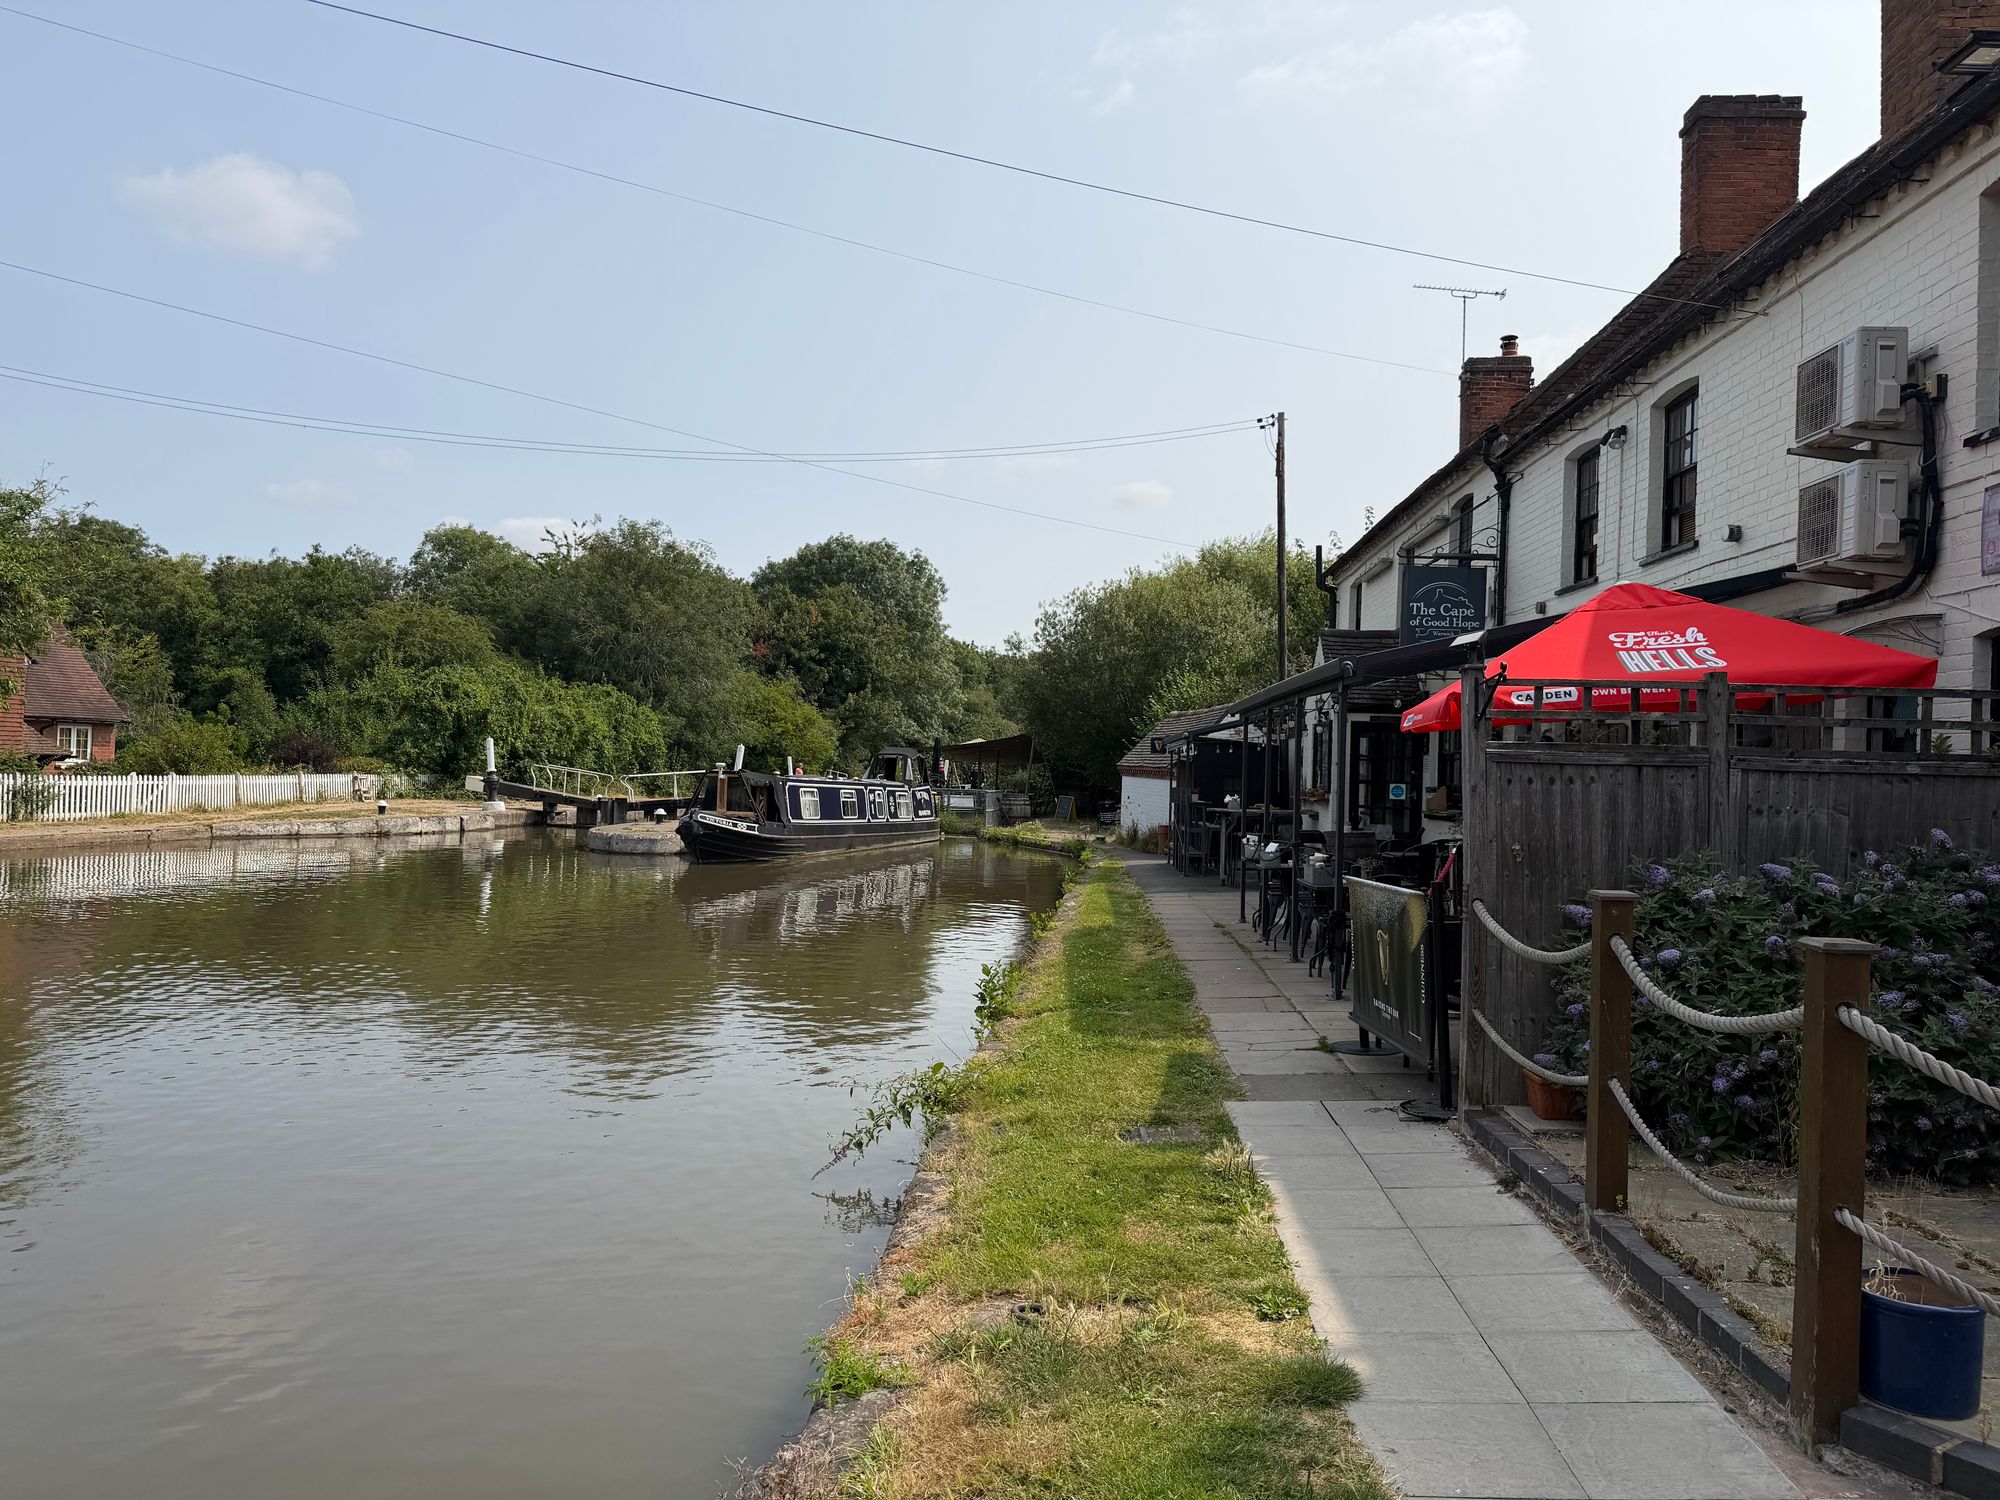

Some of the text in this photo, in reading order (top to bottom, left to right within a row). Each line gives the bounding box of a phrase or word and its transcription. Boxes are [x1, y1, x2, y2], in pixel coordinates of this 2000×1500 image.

[1409, 602, 1475, 627] The Cape
[1409, 616, 1480, 630] of Good Hope
[1608, 626, 1708, 649] Fresh
[1616, 647, 1728, 673] HELLS
[1516, 690, 1573, 702] CADEN
[1591, 688, 1618, 696] OWN
